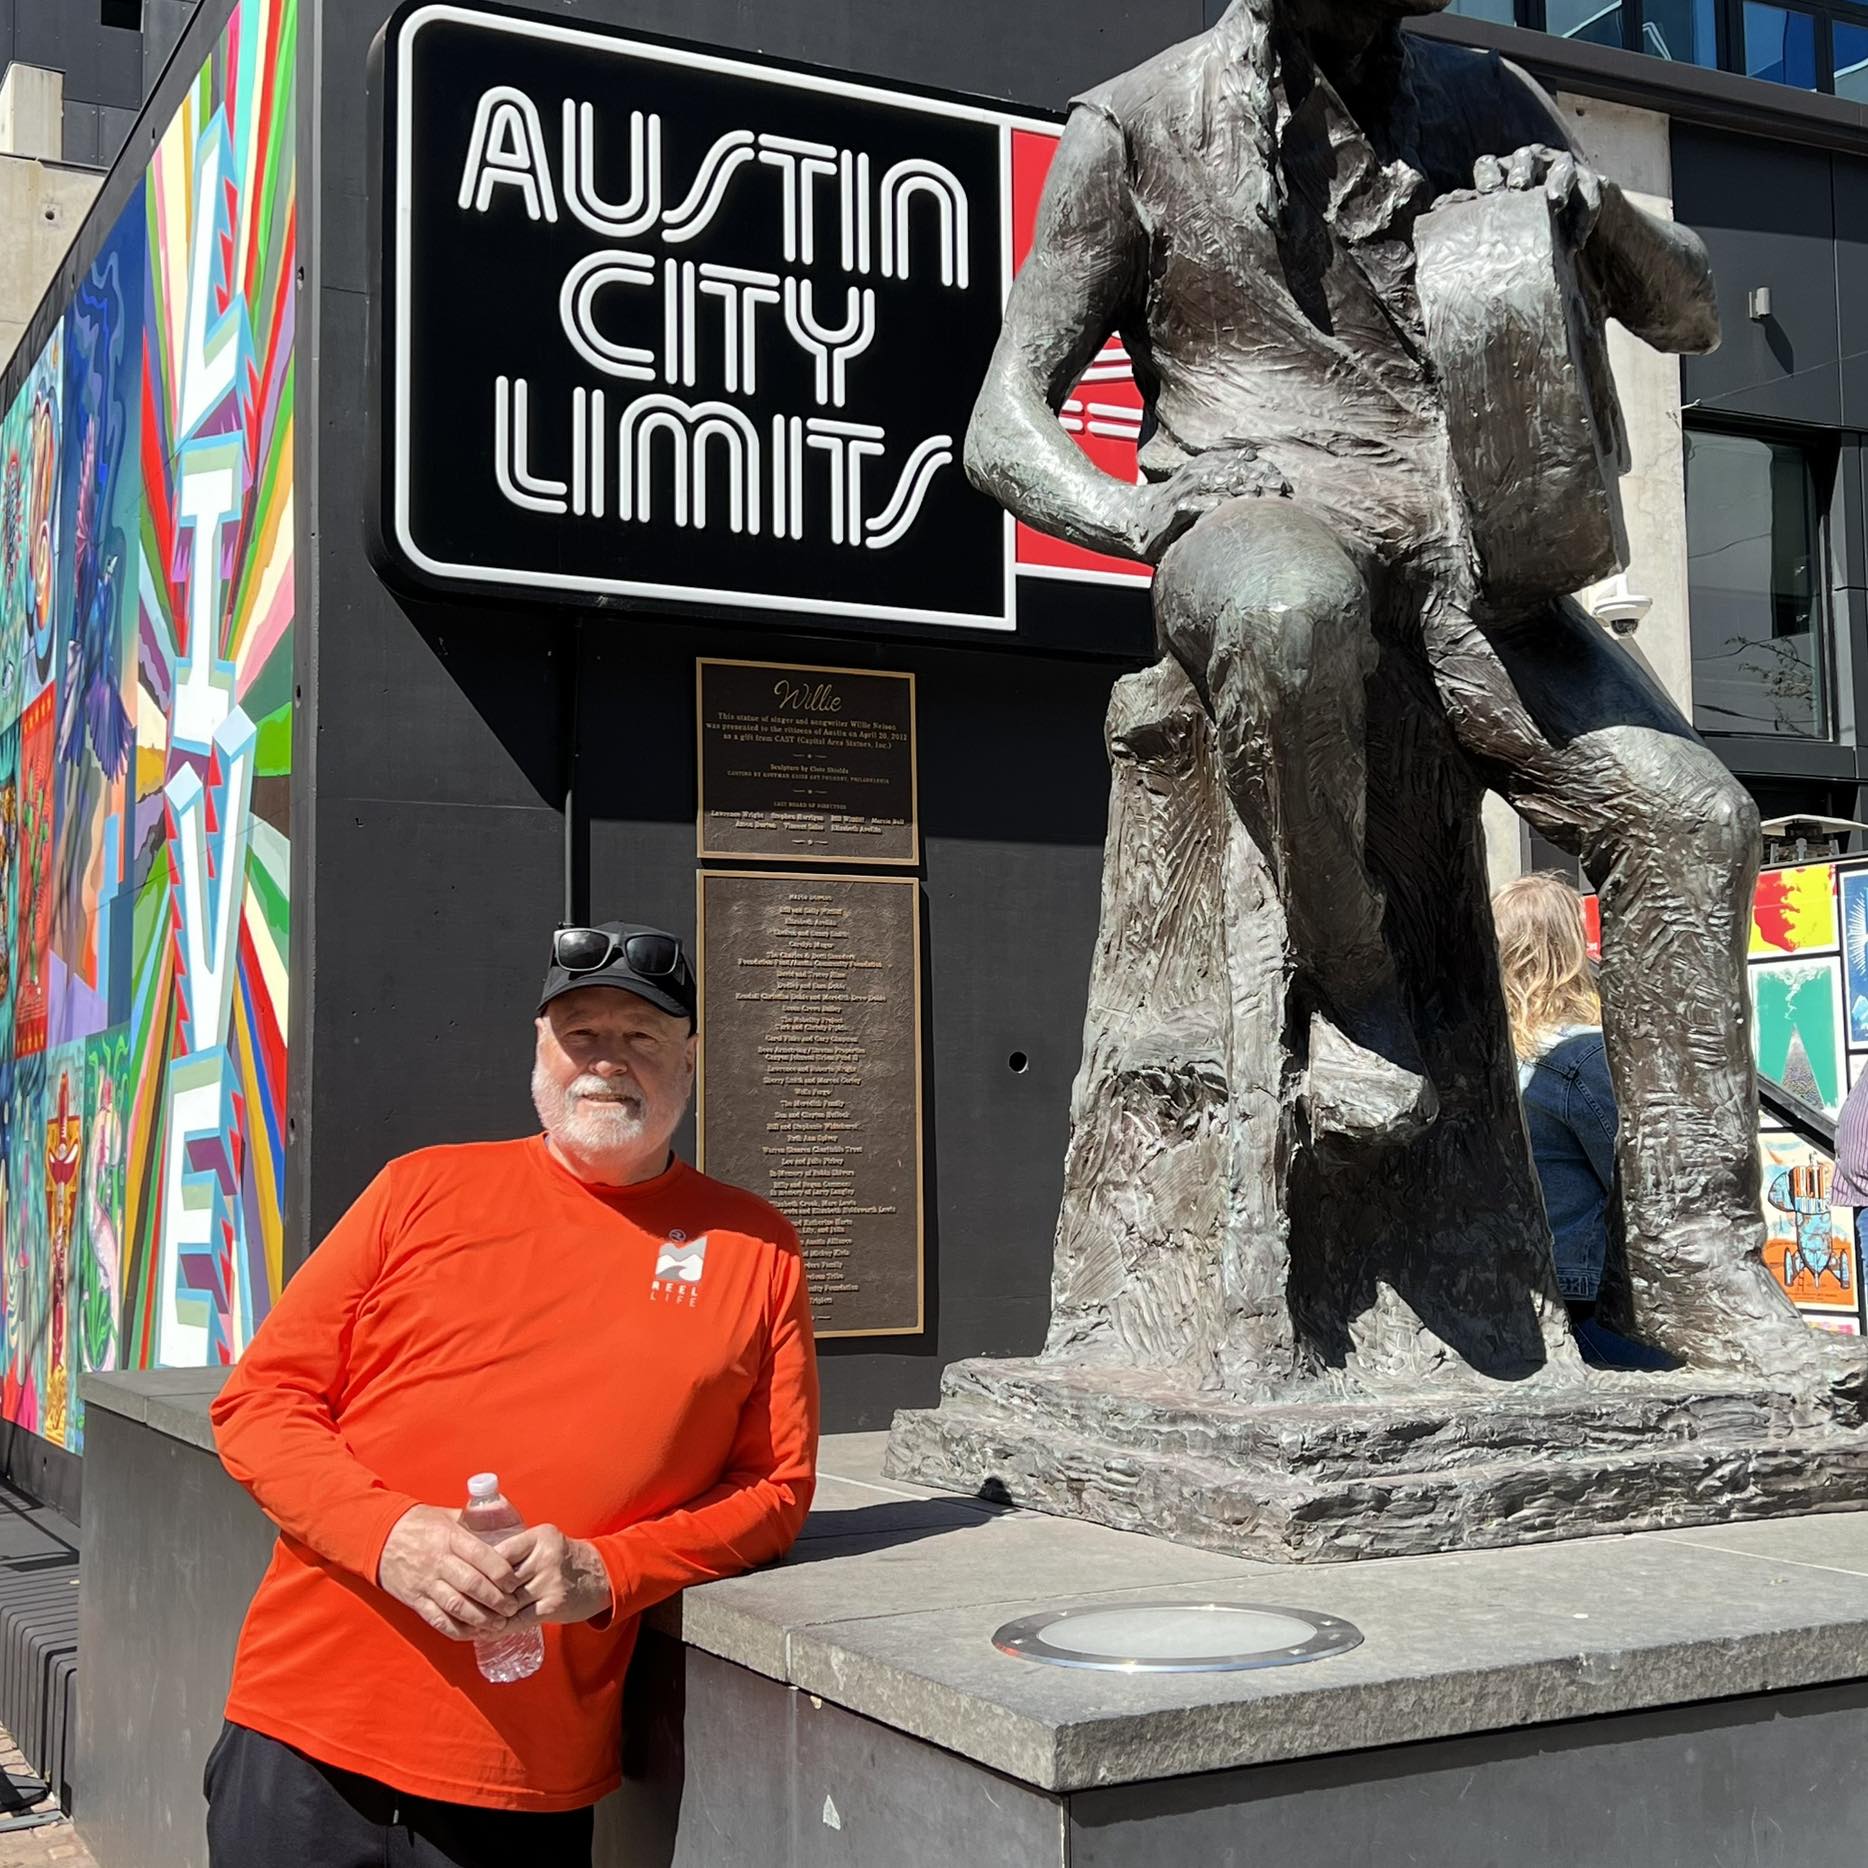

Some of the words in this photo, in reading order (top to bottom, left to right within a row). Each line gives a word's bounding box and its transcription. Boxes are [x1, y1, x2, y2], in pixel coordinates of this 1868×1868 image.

[458, 86, 969, 289] AUSTIN
[559, 249, 875, 407] CITY
[495, 375, 953, 549] LIMITS
[774, 680, 842, 712] Willie
[718, 712, 734, 720] This
[736, 714, 759, 722] statue
[771, 716, 794, 724] singer
[795, 717, 808, 725] and
[810, 719, 848, 728] songwriter
[850, 720, 871, 729] Willie
[873, 722, 897, 731] Nelson
[722, 724, 759, 732] presented
[770, 725, 782, 733] the
[823, 729, 847, 737] Austin
[859, 731, 877, 740] April
[740, 734, 754, 742] gift
[755, 734, 773, 742] from
[774, 735, 794, 743] CAST
[770, 763, 799, 771] Sculpture
[801, 765, 808, 773] by
[651, 1281, 698, 1297] REEL
[650, 1292, 696, 1308] LIFE
